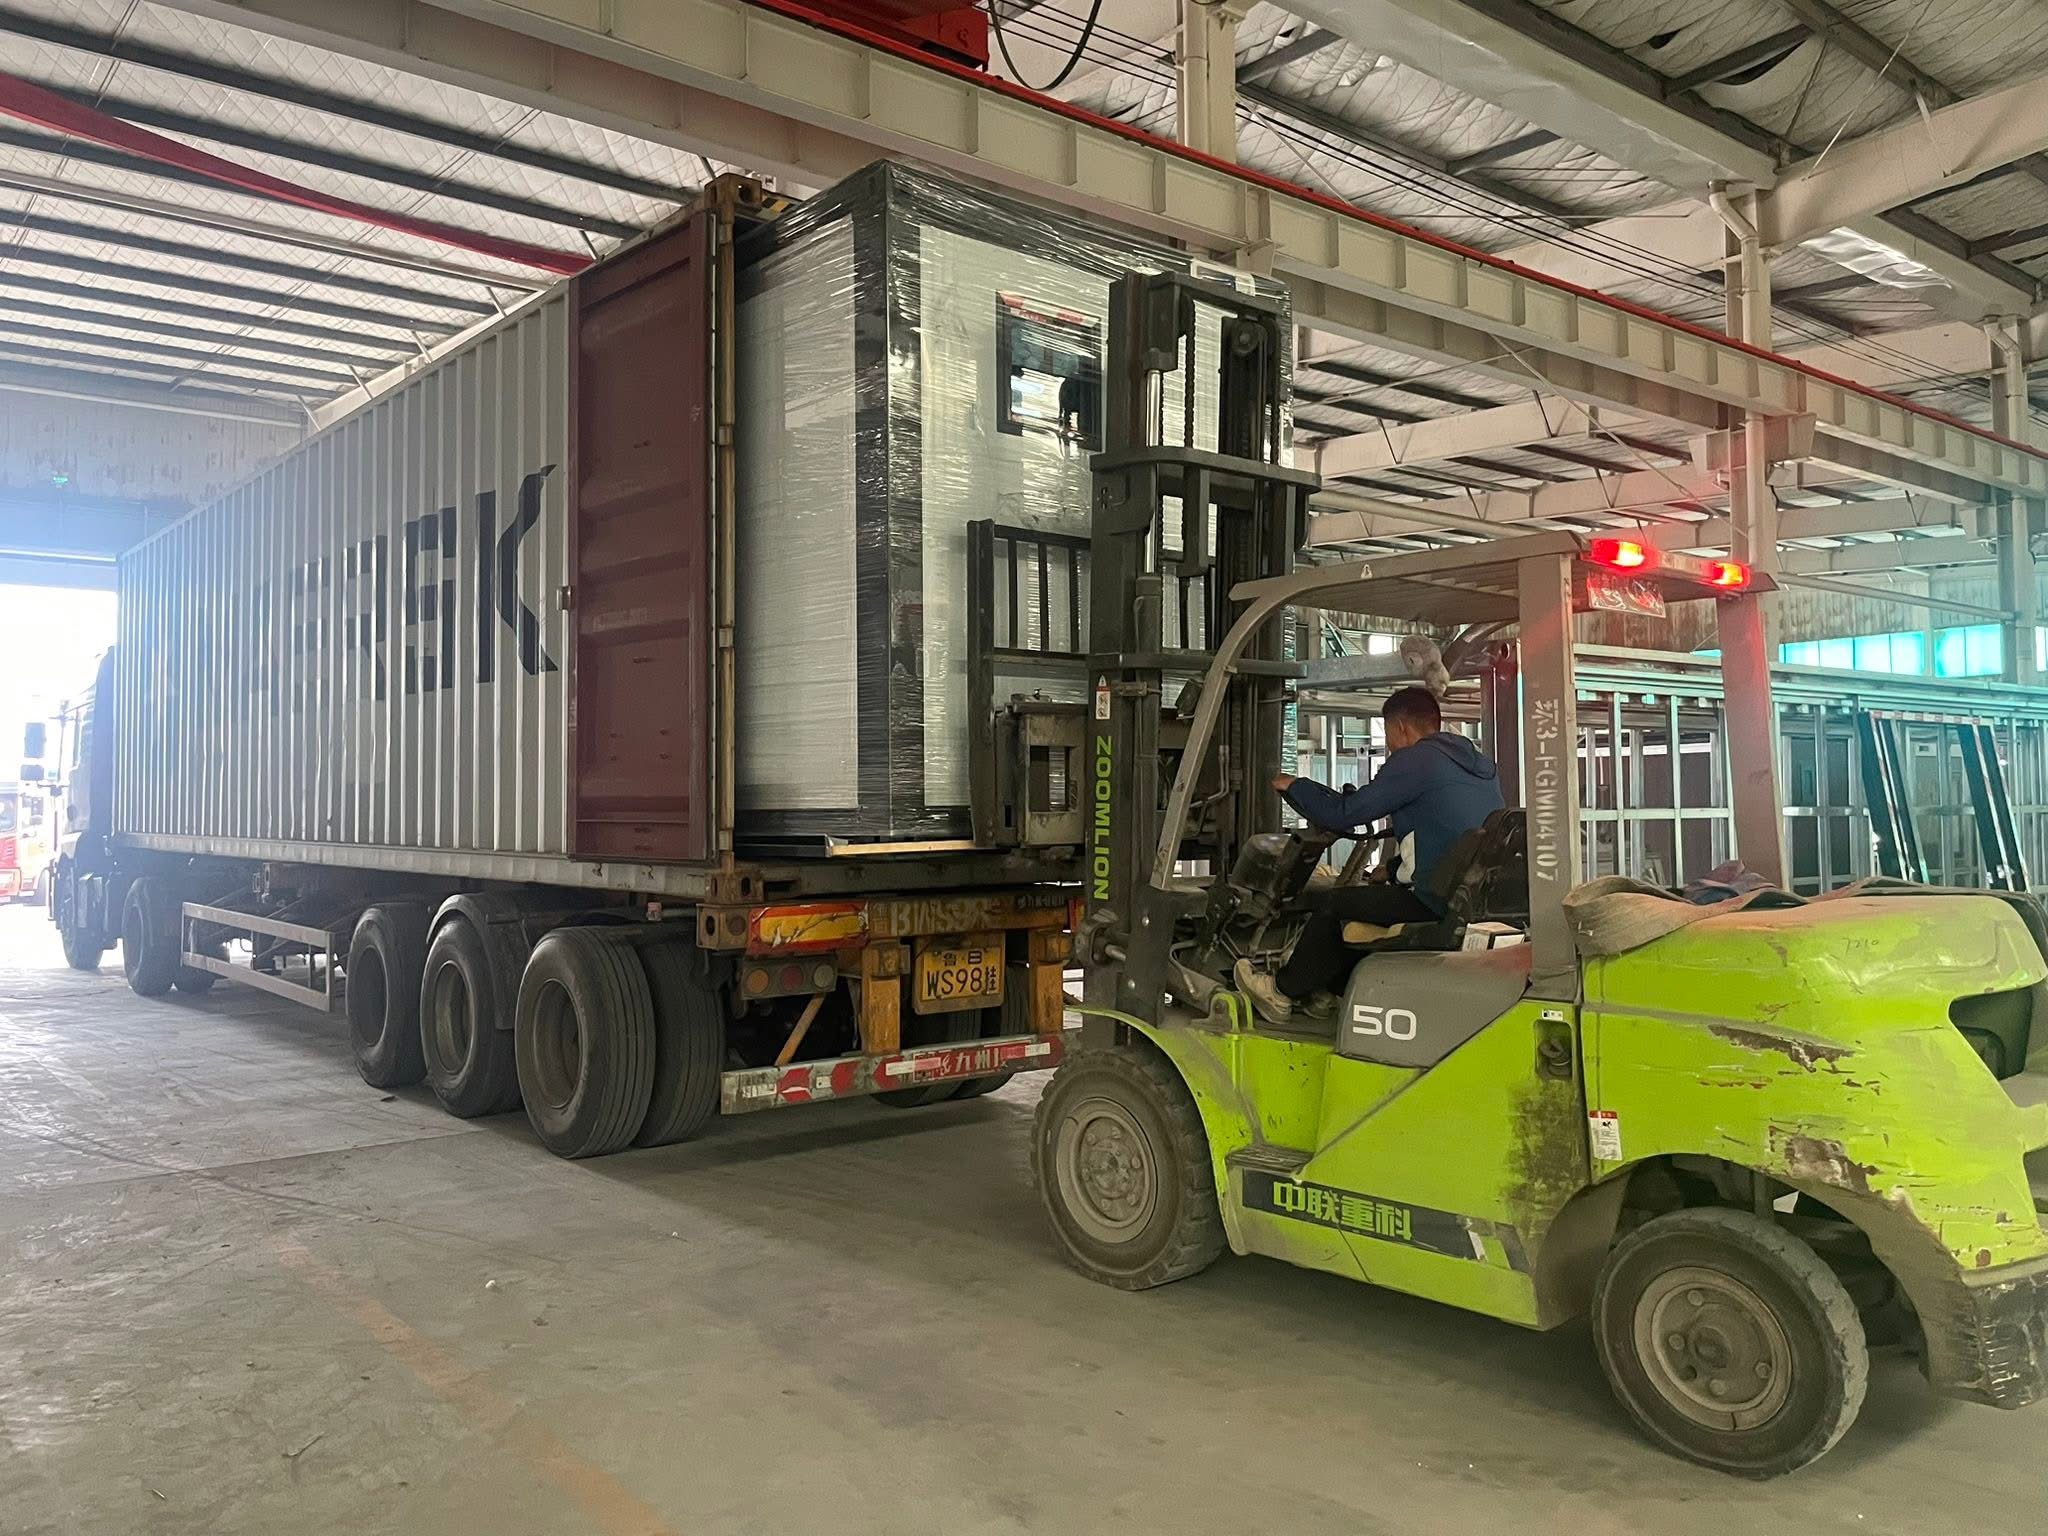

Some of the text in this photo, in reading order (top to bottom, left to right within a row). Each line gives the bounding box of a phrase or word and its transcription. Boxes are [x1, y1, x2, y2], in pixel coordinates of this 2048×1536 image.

[1093, 735, 1111, 900] ZOOMLION
[1352, 1004, 1417, 1041] 50
[1273, 1180, 1413, 1242] 中联重科
